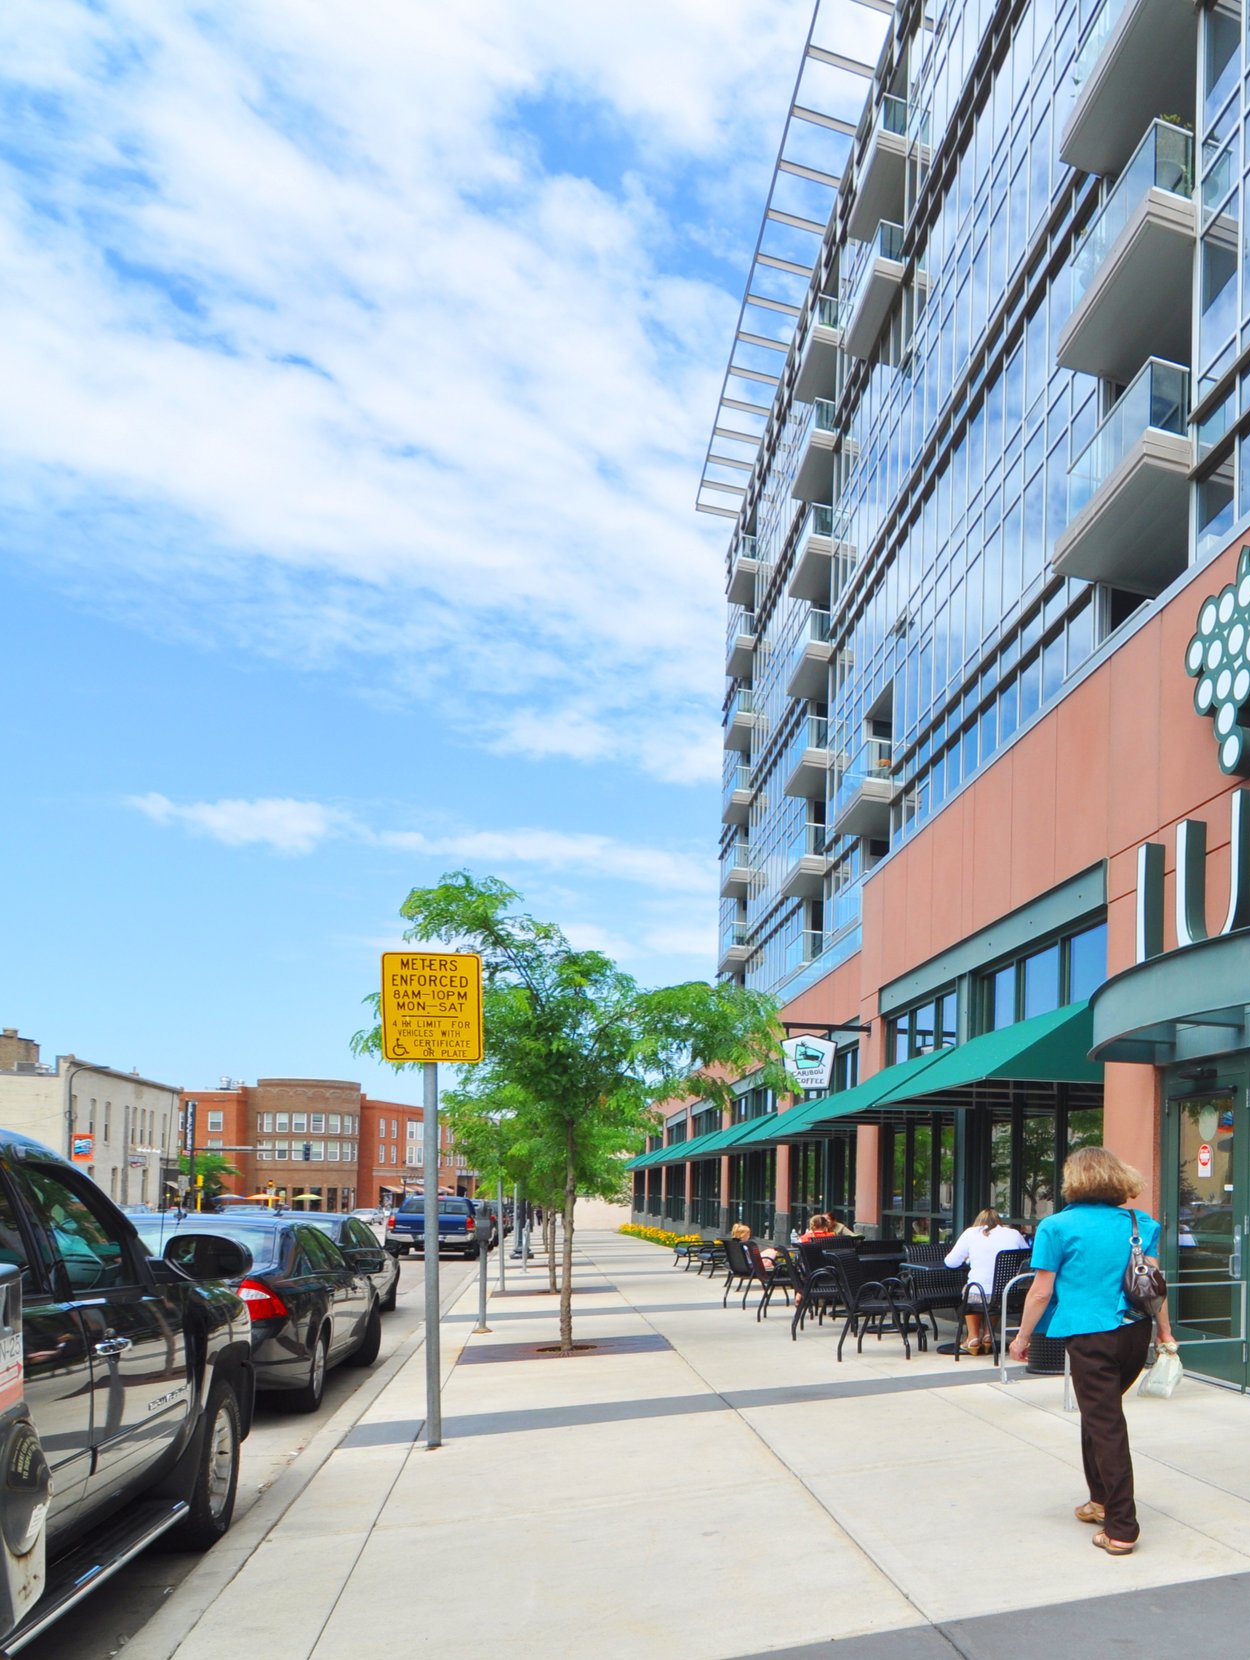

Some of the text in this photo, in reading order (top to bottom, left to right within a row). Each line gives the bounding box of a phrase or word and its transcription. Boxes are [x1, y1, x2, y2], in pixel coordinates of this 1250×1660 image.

[401, 958, 458, 971] METERS
[392, 974, 468, 988] ENFORCED
[402, 1020, 412, 1028] HR
[452, 1021, 470, 1029] FOR
[398, 1029, 434, 1037] VEHICLES
[413, 1039, 471, 1048] CERTIFICATE
[423, 1049, 435, 1057] OR
[791, 1067, 824, 1077] CARIBOU
